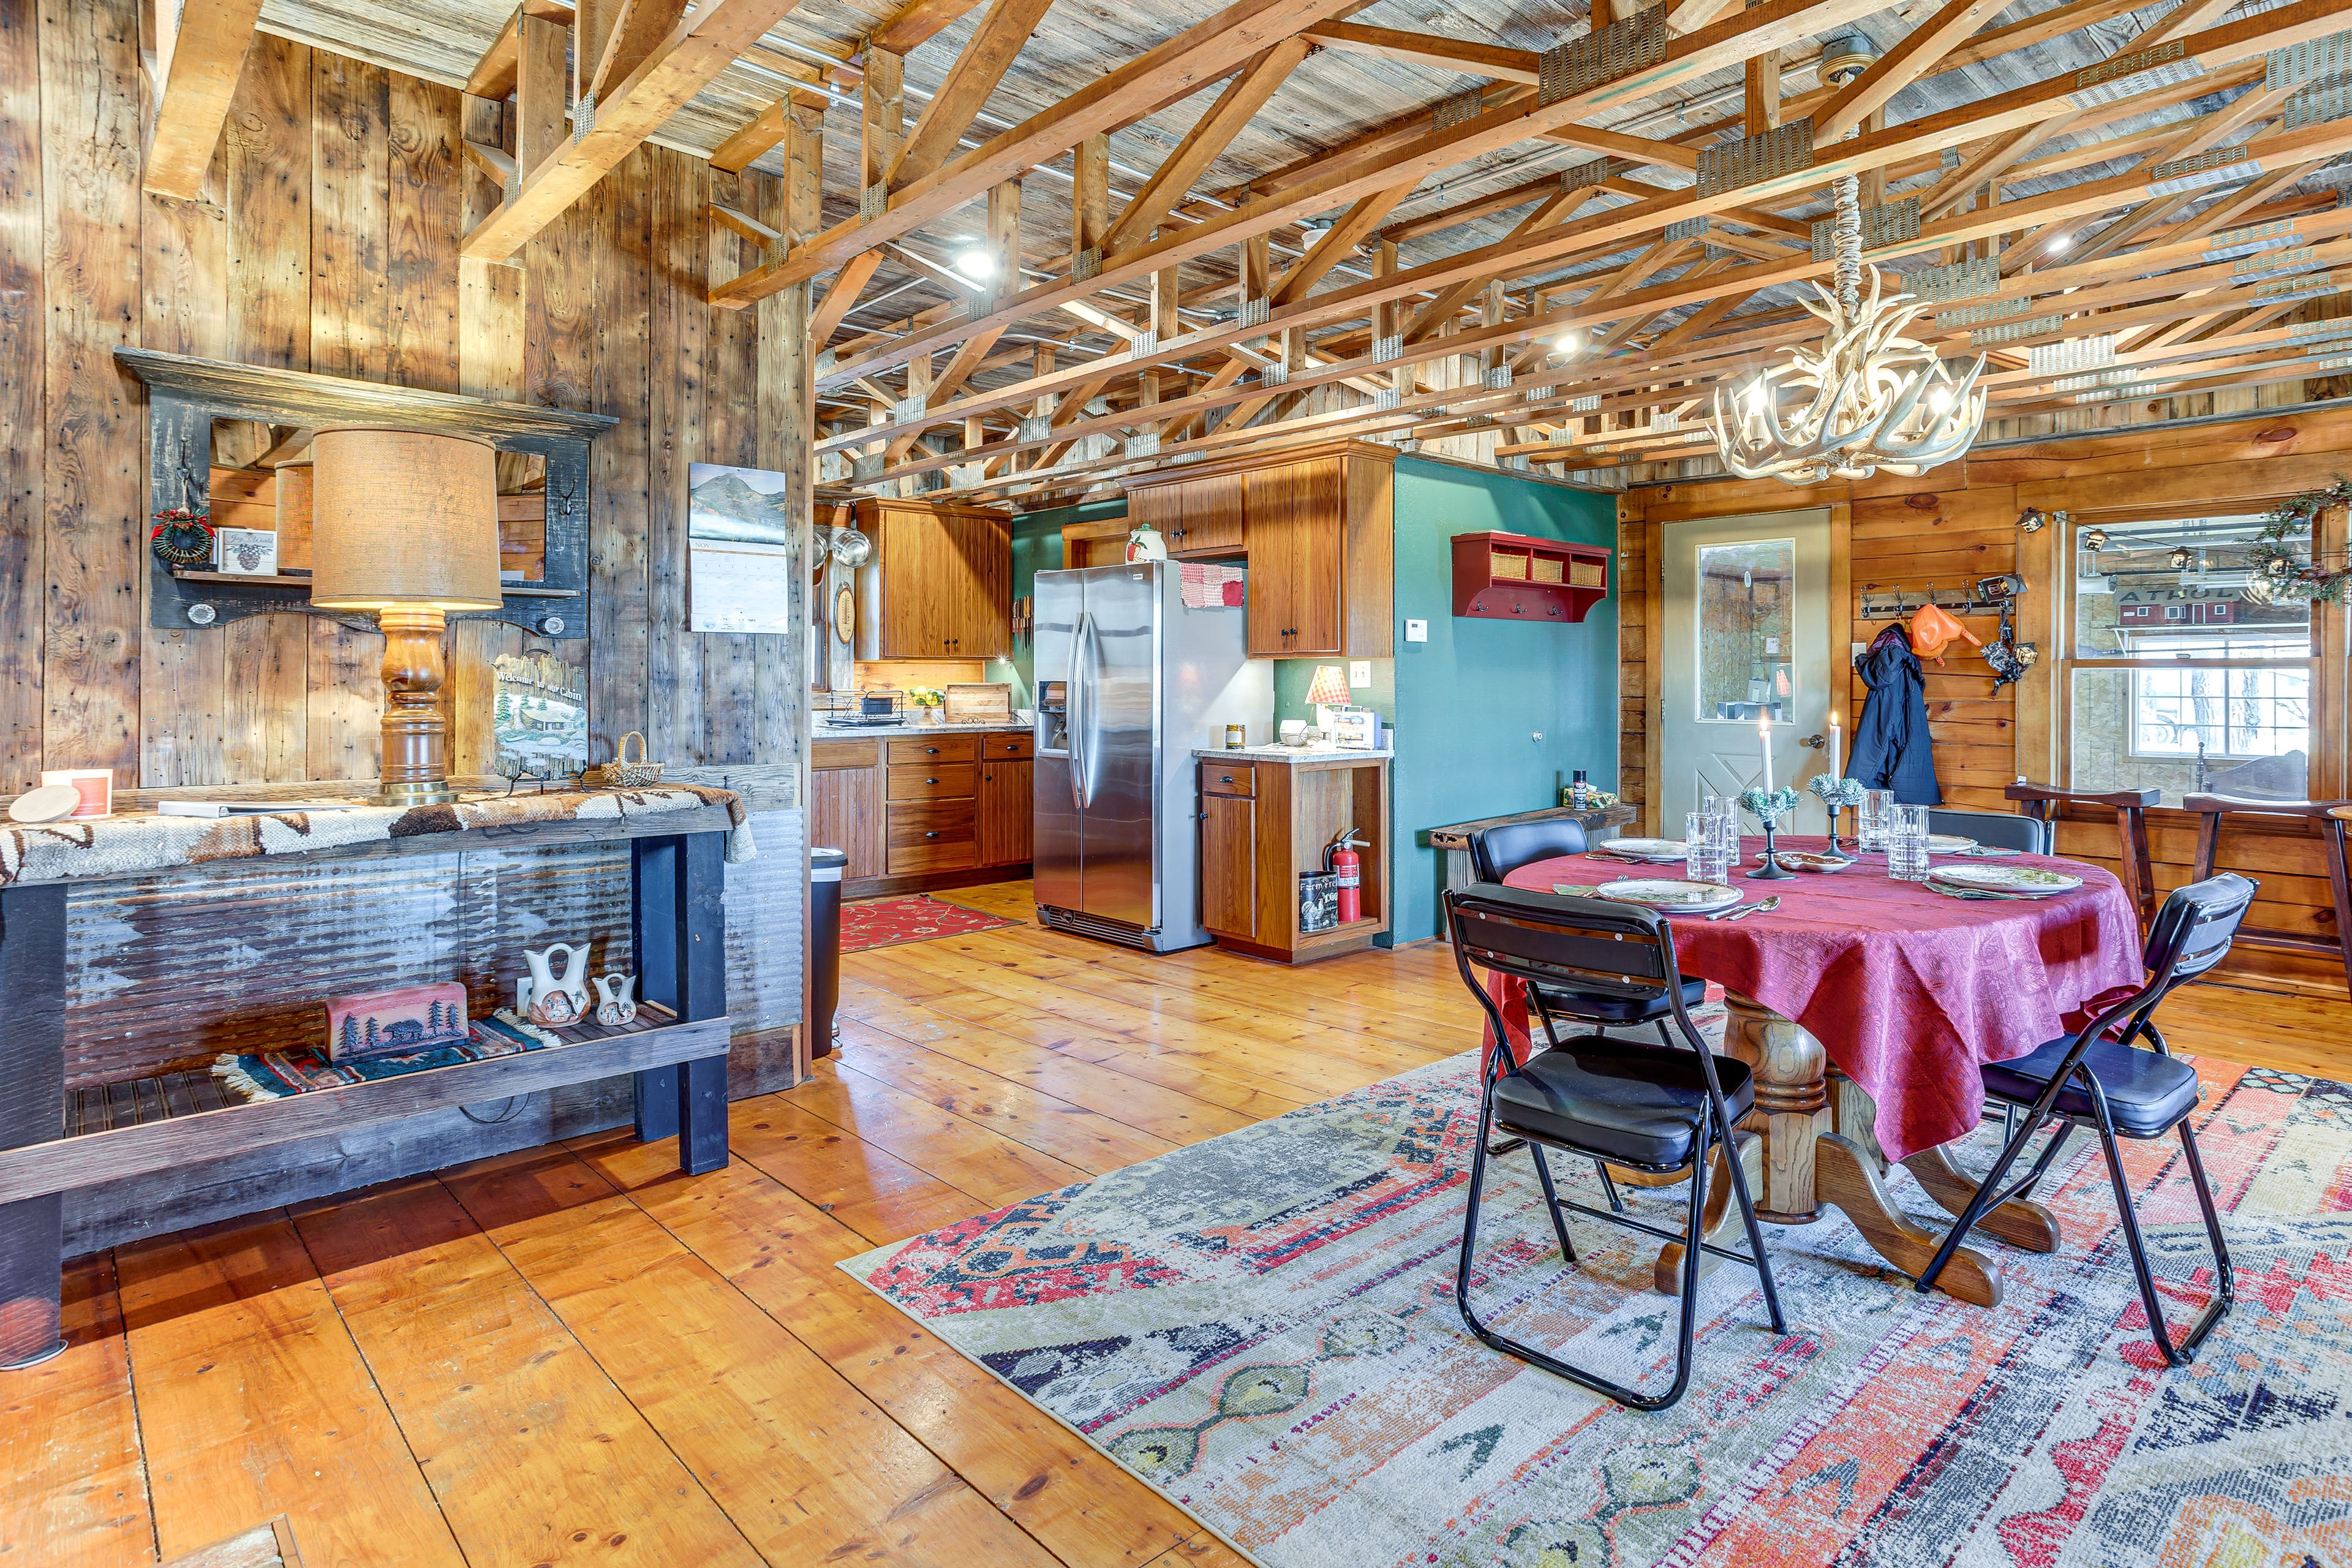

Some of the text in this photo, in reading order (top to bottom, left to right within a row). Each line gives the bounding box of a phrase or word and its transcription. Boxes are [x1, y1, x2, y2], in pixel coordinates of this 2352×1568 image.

[2119, 587, 2233, 602] ATHOL
[496, 671, 533, 685] Welcome
[560, 686, 582, 702] Cabin
